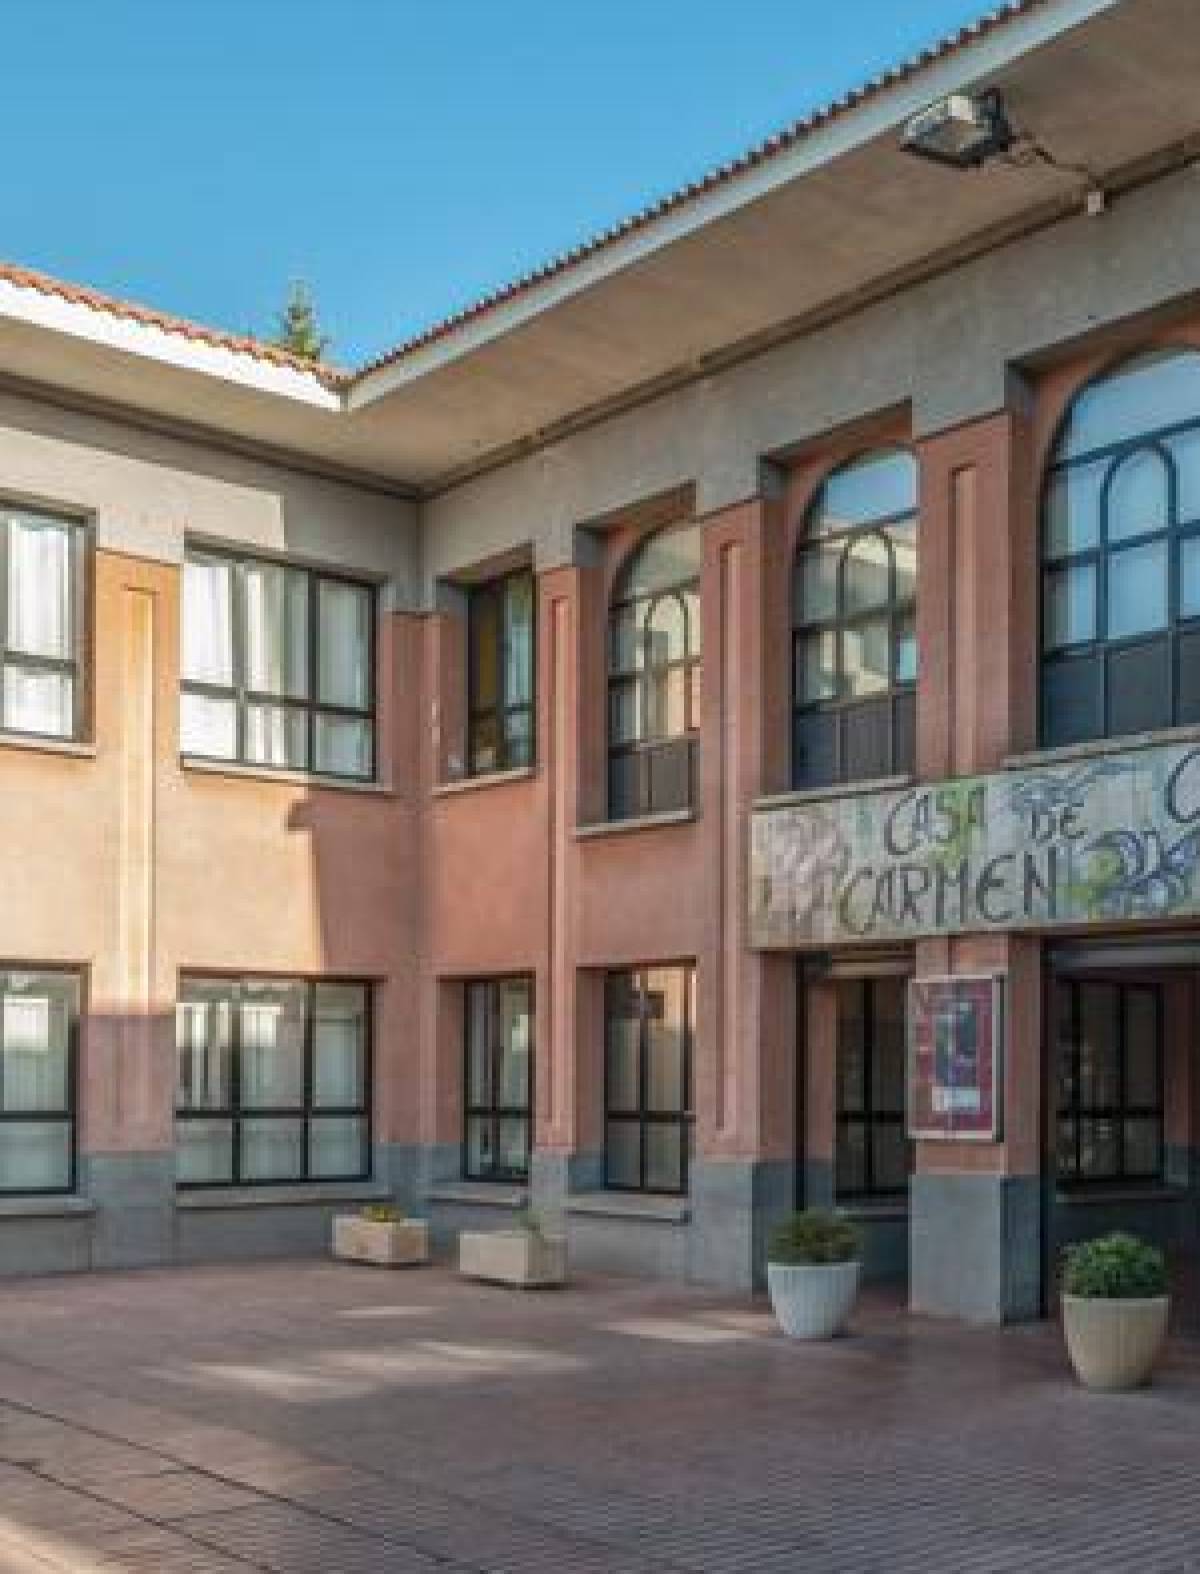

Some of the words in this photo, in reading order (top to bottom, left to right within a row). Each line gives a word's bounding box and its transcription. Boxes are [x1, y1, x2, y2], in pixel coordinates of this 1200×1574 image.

[884, 785, 988, 856] CASA
[1029, 801, 1088, 842] DE
[838, 847, 1057, 935] CARMEN
